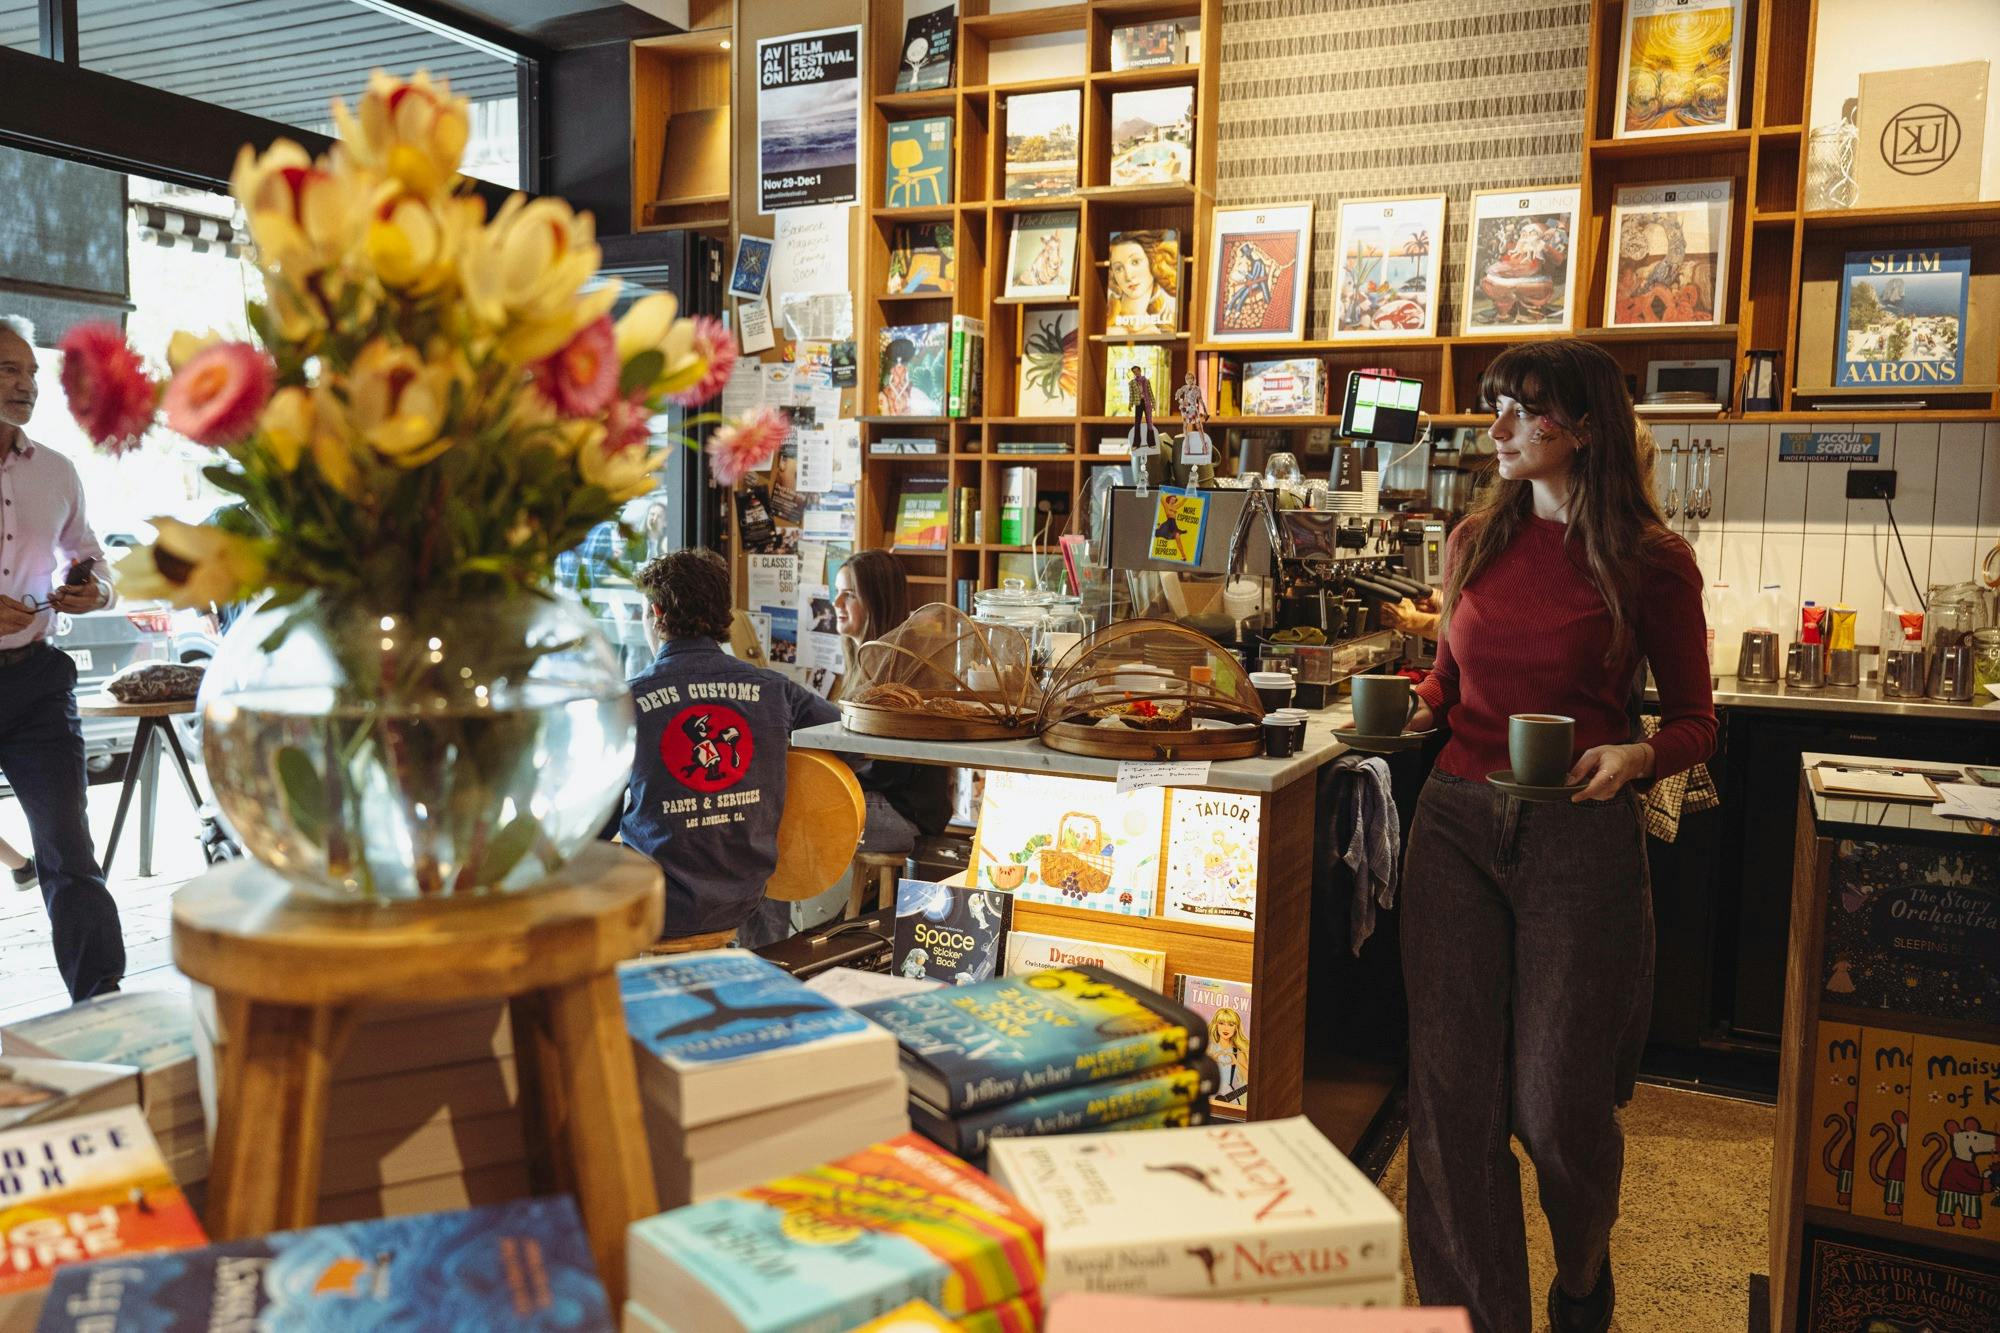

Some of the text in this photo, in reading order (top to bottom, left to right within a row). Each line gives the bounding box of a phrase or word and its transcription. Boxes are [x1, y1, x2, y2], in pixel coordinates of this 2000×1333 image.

[764, 46, 782, 60] AV
[790, 40, 823, 56] FILM
[764, 60, 782, 73] AL
[791, 49, 854, 69] FESTIVAL
[763, 71, 783, 85] ON
[791, 66, 824, 82] 2024
[764, 179, 782, 190] Nov
[816, 174, 821, 184] 1
[1869, 252, 1941, 274] SLIM
[1843, 361, 1956, 382] AARONS
[1817, 434, 1861, 444] JACQUI
[1816, 443, 1872, 454] SCRUBY
[1183, 507, 1196, 515] MORE
[1177, 514, 1199, 525] ESPRESSO
[1155, 547, 1177, 556] DEPRESSO
[1156, 540, 1168, 548] LESS
[762, 557, 794, 568] CLASSES
[779, 570, 793, 579] FOR
[779, 582, 793, 593] $60
[636, 682, 761, 713] DEUS CUSTOMS
[662, 789, 761, 814] PARTS & SERVICES
[1195, 801, 1250, 823] TAYLOR
[686, 818, 698, 828] LOS
[1911, 888, 1991, 914] The Story
[1195, 905, 1207, 914] Story
[1218, 908, 1241, 916] superstar
[1891, 899, 1998, 929] Orchestra
[914, 924, 975, 951] Space
[1894, 938, 1948, 953] SLEEPING
[932, 946, 963, 959] Sticker
[1049, 947, 1104, 968] Dragon
[936, 957, 957, 968] Book
[1192, 989, 1229, 1008] TAYLOR
[1928, 1055, 2000, 1080] Maisy
[1947, 1085, 1973, 1109] of
[1206, 1128, 1316, 1222] Nexus
[1232, 1240, 1350, 1283] Nexus
[1854, 1262, 1937, 1289] NATURAL
[1894, 1283, 1973, 1317] DRAGONS
